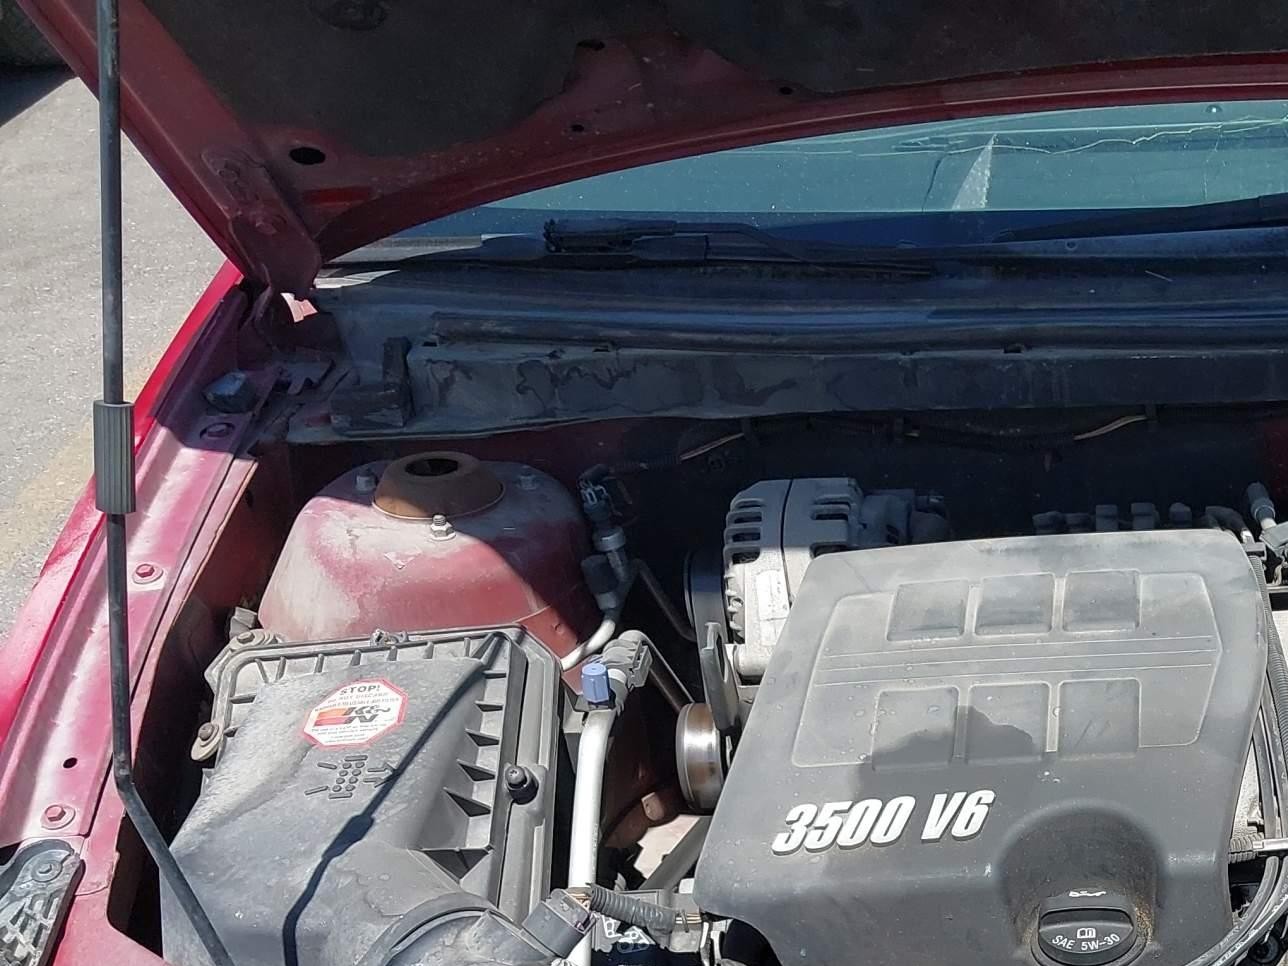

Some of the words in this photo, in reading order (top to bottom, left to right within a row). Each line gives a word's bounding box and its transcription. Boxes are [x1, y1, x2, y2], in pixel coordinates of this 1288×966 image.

[340, 685, 380, 695] STOP!
[771, 796, 916, 854] 3500
[921, 790, 995, 842] V6
[1052, 935, 1075, 949] SAE
[1081, 933, 1120, 950] 5W-30
